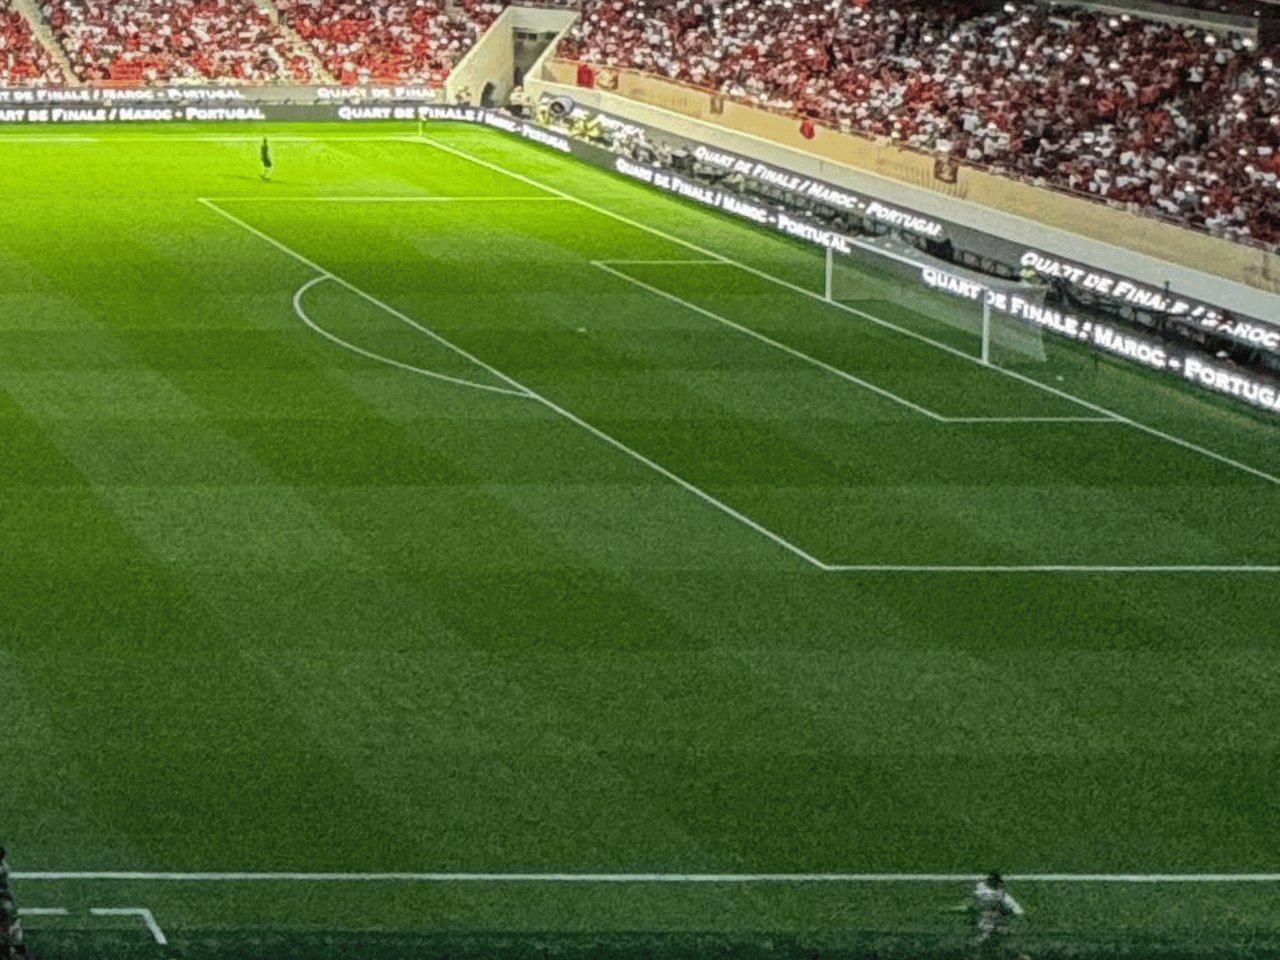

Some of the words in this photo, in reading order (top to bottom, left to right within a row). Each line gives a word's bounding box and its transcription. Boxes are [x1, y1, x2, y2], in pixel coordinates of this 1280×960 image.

[923, 267, 985, 302] QUART
[1009, 297, 1079, 334] FINALE
[1092, 324, 1166, 368] MAROC
